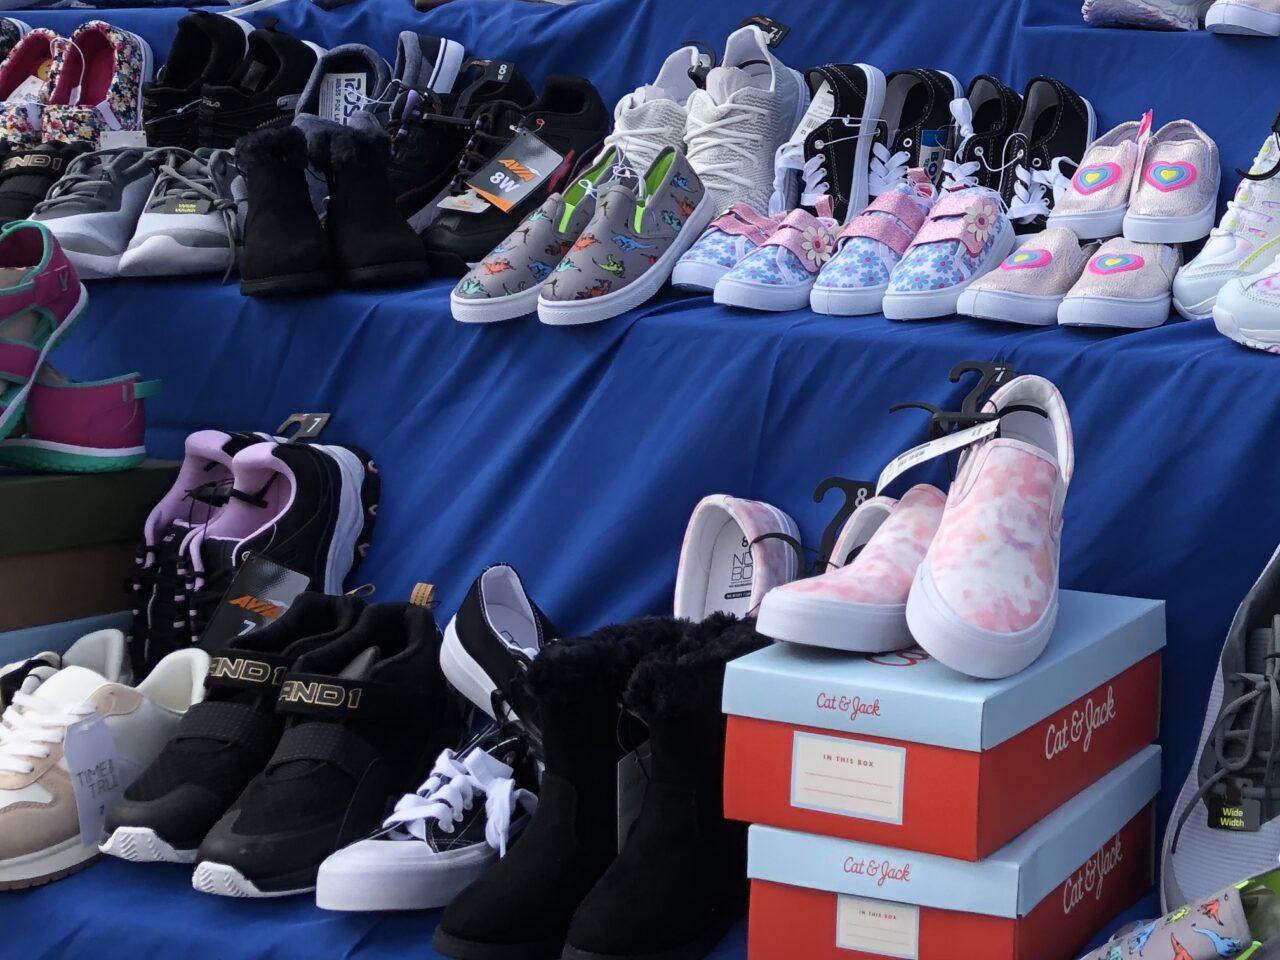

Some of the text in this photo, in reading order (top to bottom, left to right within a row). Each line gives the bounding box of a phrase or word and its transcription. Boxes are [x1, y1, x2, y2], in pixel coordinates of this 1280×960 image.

[498, 64, 508, 75] 8
[489, 171, 520, 193] 8W
[994, 367, 1006, 383] 7
[306, 417, 322, 433] 7
[854, 487, 868, 508] 8
[816, 692, 881, 721] Cat & Jack
[1045, 686, 1116, 760] Cat & Jack
[836, 755, 854, 765] THIS
[857, 758, 874, 767] BOX
[1222, 807, 1244, 818] Wide
[1220, 817, 1245, 828] Width
[843, 856, 911, 887] Cat & Jack
[1063, 833, 1123, 914] Cat & Jack
